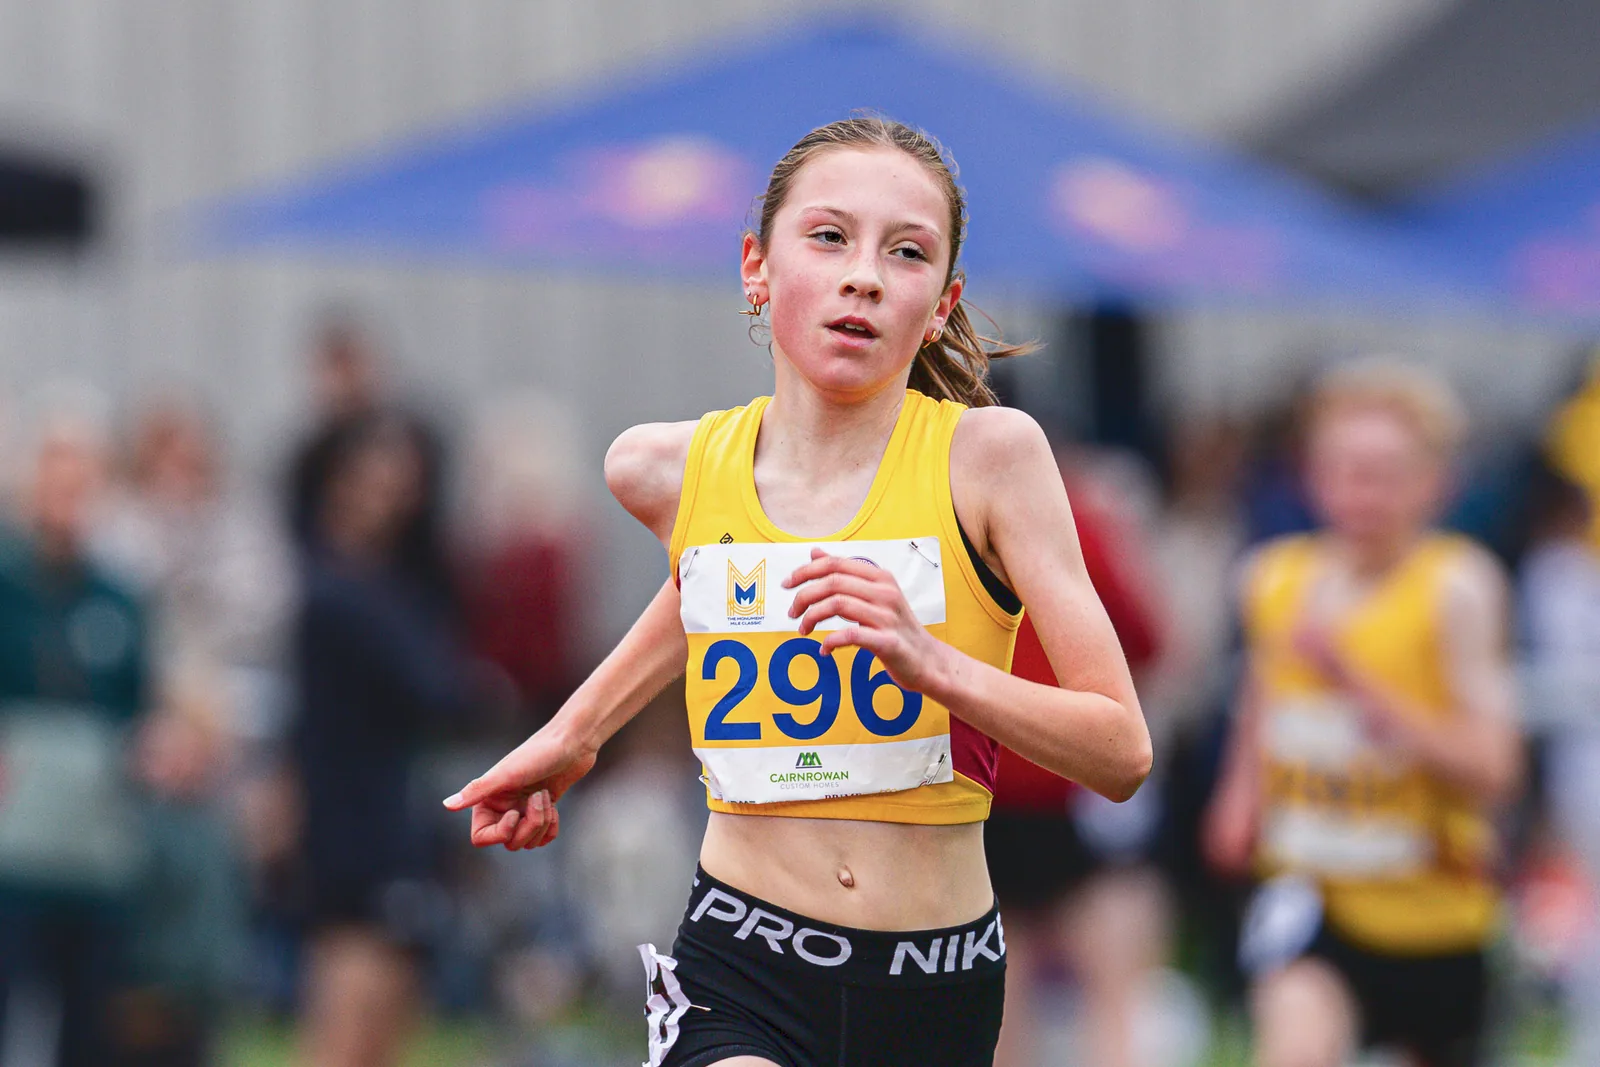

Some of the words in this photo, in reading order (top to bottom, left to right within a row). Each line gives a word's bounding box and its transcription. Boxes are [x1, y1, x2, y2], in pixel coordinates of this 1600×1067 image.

[702, 638, 923, 740] 296
[769, 770, 849, 783] CAIRNROWAN
[813, 781, 840, 789] HOMES
[690, 887, 852, 967] PRO
